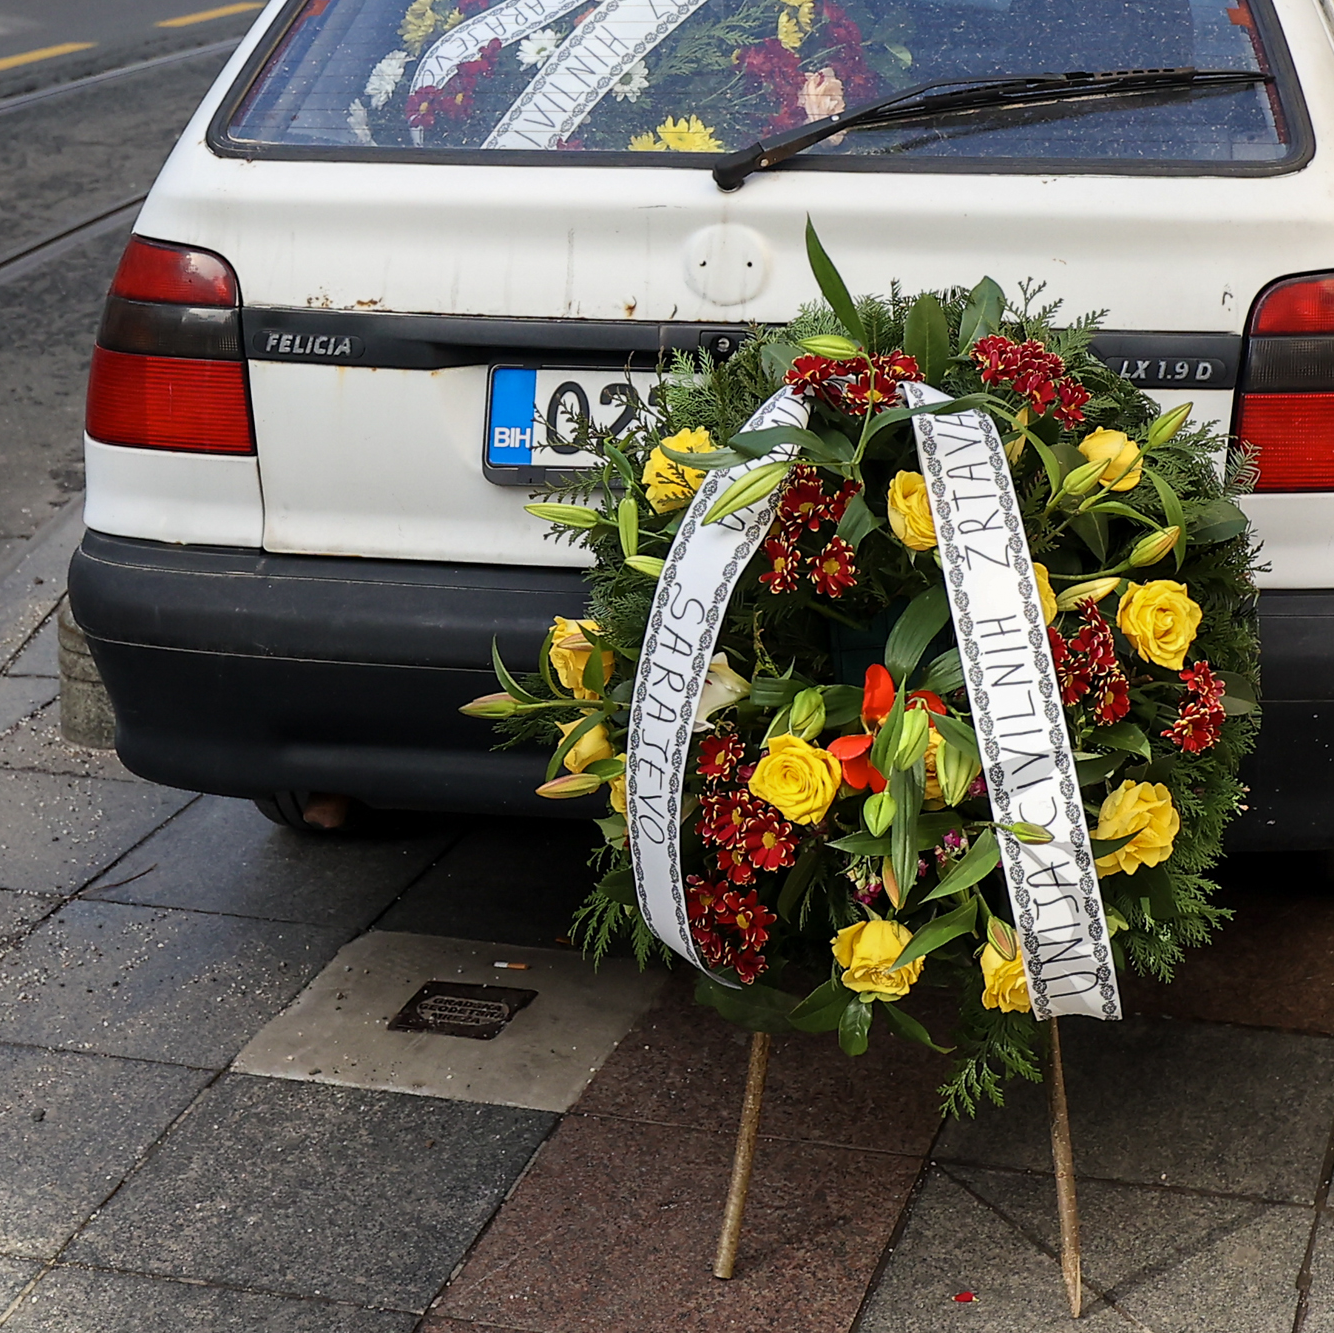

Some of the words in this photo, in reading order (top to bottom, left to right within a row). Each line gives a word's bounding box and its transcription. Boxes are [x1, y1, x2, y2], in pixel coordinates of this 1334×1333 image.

[497, 24, 631, 150] IVILNIH
[264, 333, 353, 357] FELICIA
[1119, 359, 1152, 380] LX
[1157, 359, 1190, 381] 1.9
[1195, 361, 1214, 381] D
[493, 426, 532, 449] BIH
[933, 412, 1011, 572] ŽRTAVA
[637, 581, 706, 846] SARAJEVO
[1025, 860, 1100, 999] UNIJA
[418, 1002, 506, 1020] GEODETSKA
[432, 997, 503, 1012] GRADSKA
